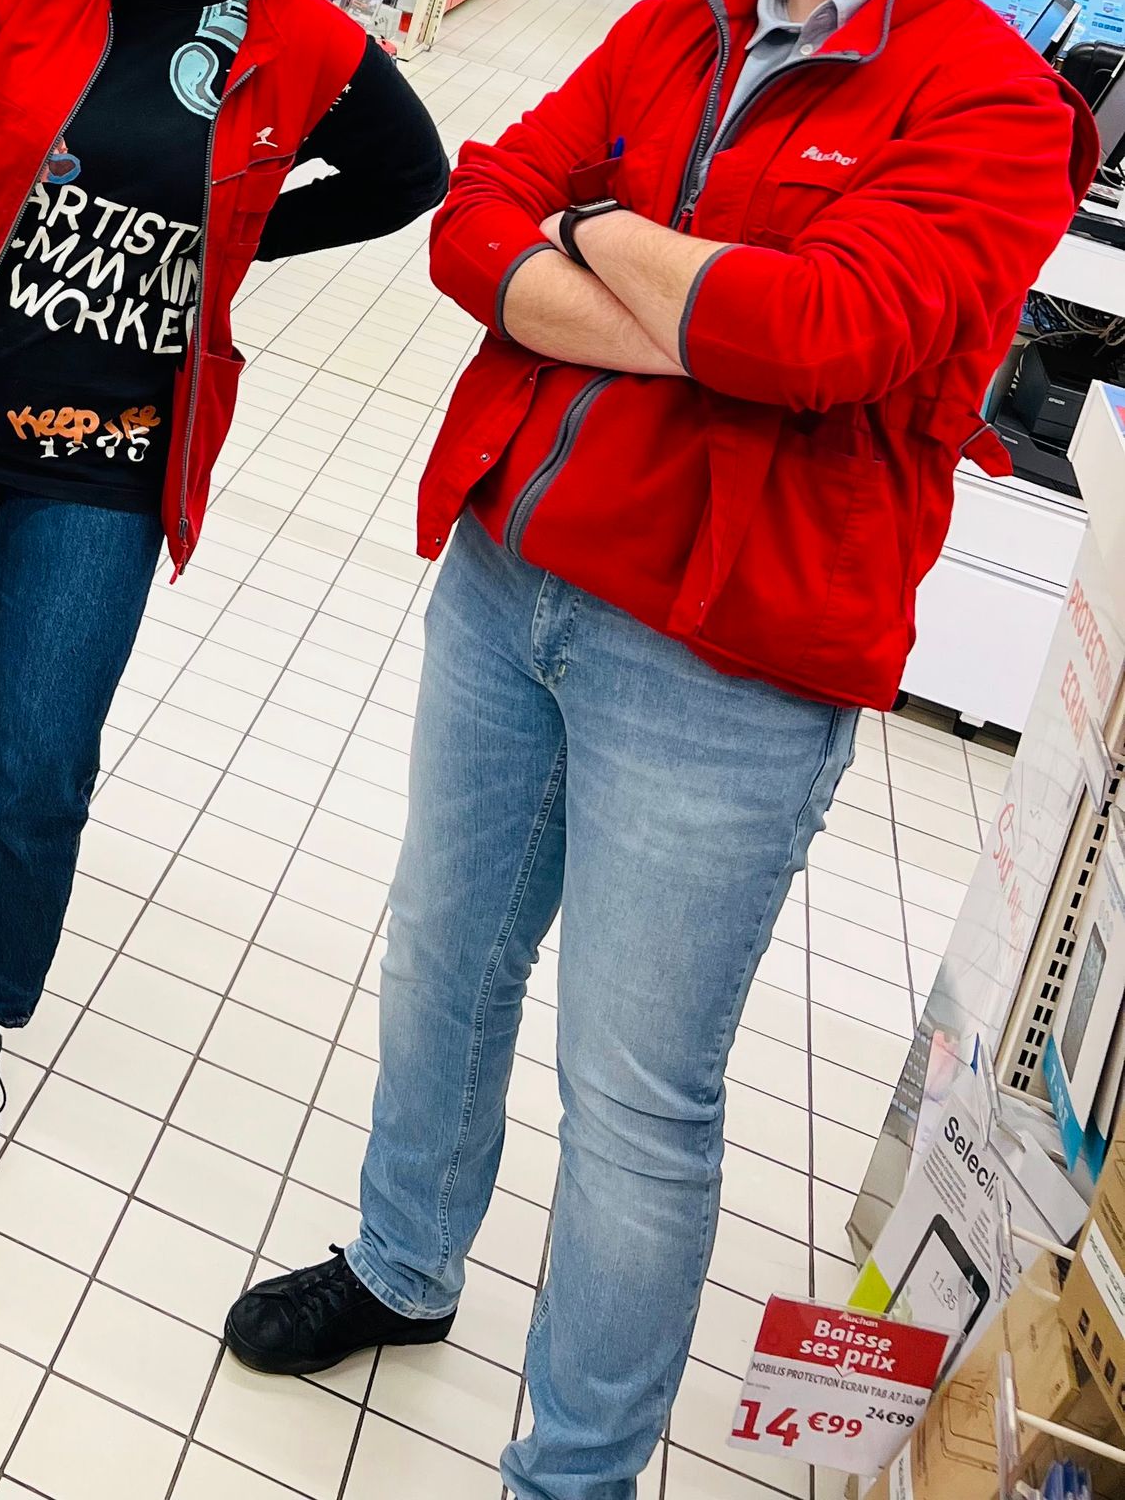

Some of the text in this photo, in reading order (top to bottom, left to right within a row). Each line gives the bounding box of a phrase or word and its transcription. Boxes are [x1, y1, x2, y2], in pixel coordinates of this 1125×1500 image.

[814, 1319, 892, 1352] Baisse
[838, 1312, 878, 1328] Auchan
[799, 1339, 896, 1377] ses prix
[751, 1362, 786, 1377] MOBILIS
[786, 1366, 839, 1387] PROTECTION
[840, 1380, 869, 1393] ECRAN
[871, 1386, 887, 1398] TAB
[888, 1390, 900, 1401] A7
[865, 1406, 915, 1428] 24€99
